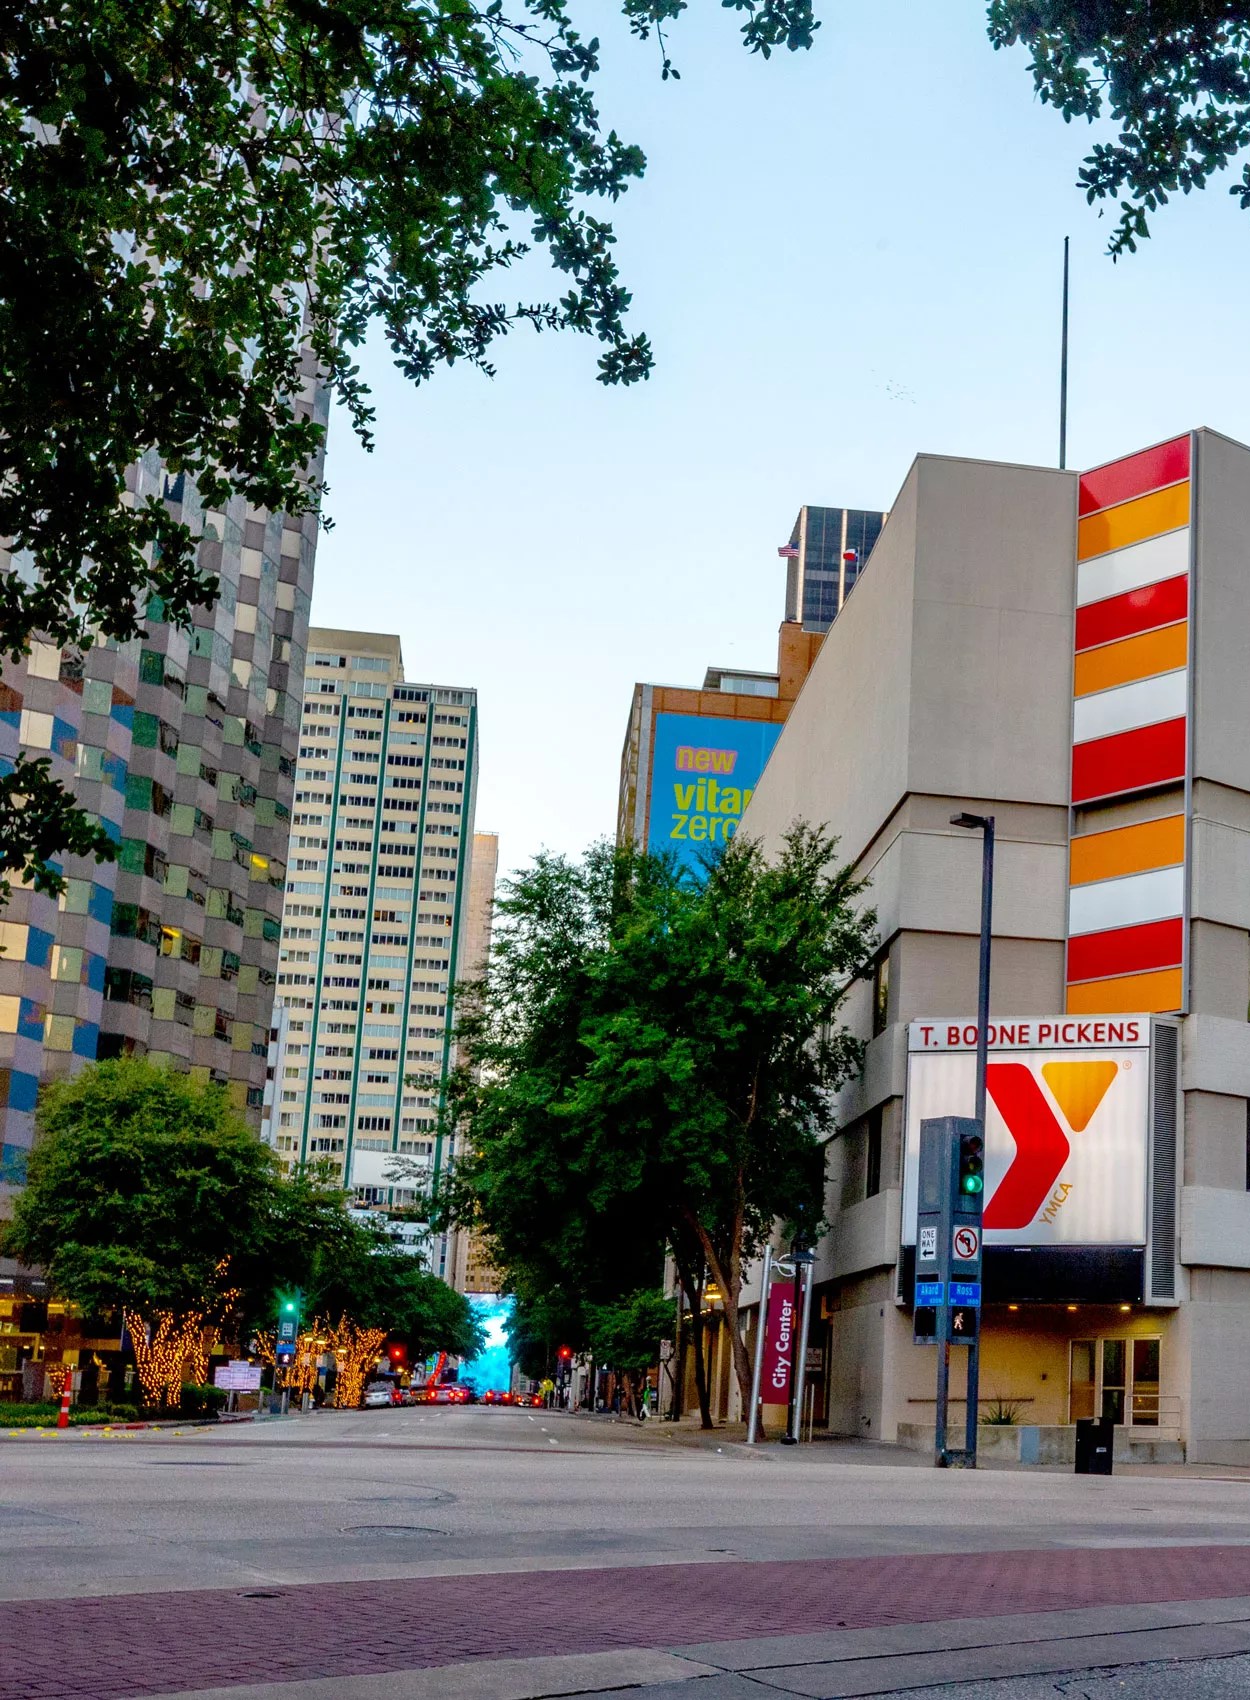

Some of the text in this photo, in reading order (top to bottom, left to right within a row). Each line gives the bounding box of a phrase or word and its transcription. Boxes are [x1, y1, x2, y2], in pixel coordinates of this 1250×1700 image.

[678, 747, 736, 772] new
[920, 1021, 1140, 1047] T. BOONE PICKENS
[1038, 1182, 1074, 1225] YMCA
[921, 1239, 935, 1248] WAY
[922, 1230, 935, 1239] ONE
[956, 1285, 973, 1296] Ross
[772, 1299, 793, 1389] City Center
